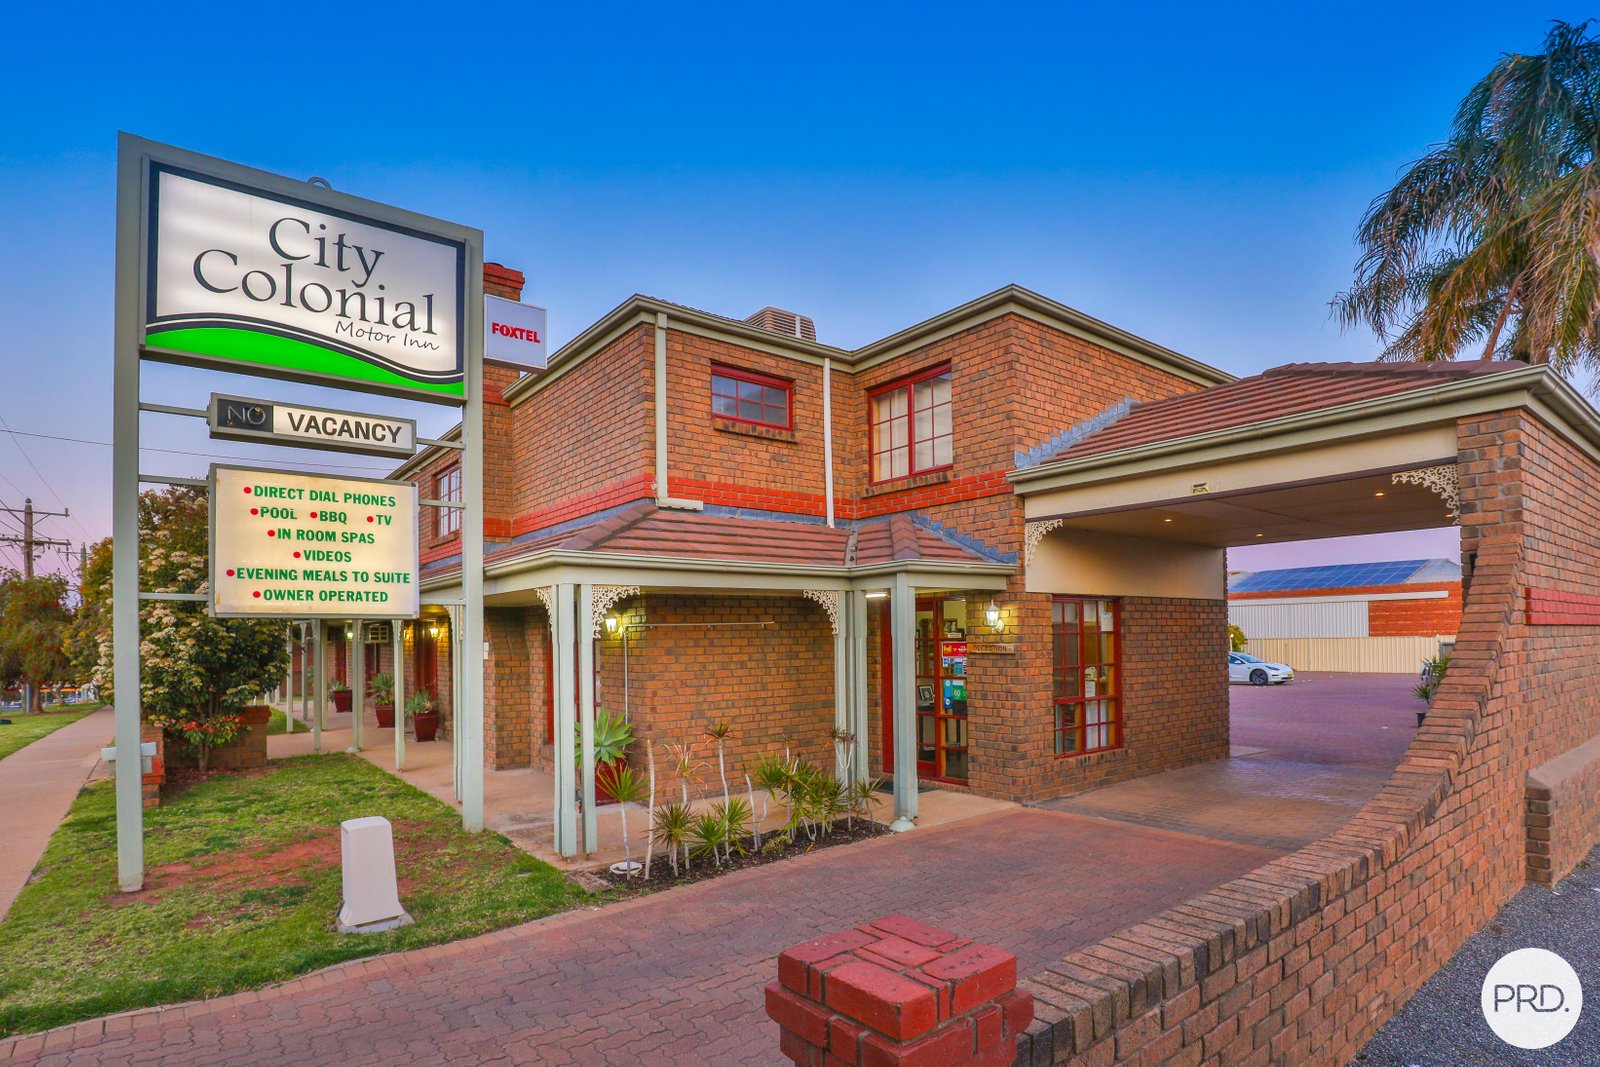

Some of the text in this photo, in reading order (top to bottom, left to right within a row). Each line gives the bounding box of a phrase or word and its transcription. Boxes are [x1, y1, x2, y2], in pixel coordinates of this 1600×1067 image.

[269, 217, 384, 287] City
[193, 249, 437, 335] Colonial
[335, 320, 440, 351] Motor Inn
[492, 322, 540, 343] FOXTEL
[227, 405, 402, 443] NO VACANCY
[254, 485, 396, 507] DIRECT DIAL PHONES
[260, 507, 392, 526] POOL BBQ TV
[277, 528, 375, 544] IN ROOM SPAS
[303, 550, 352, 562] VIDEOS
[236, 568, 410, 584] EVENING MEALS TO SUITE
[263, 589, 388, 603] OWNER OPERATED
